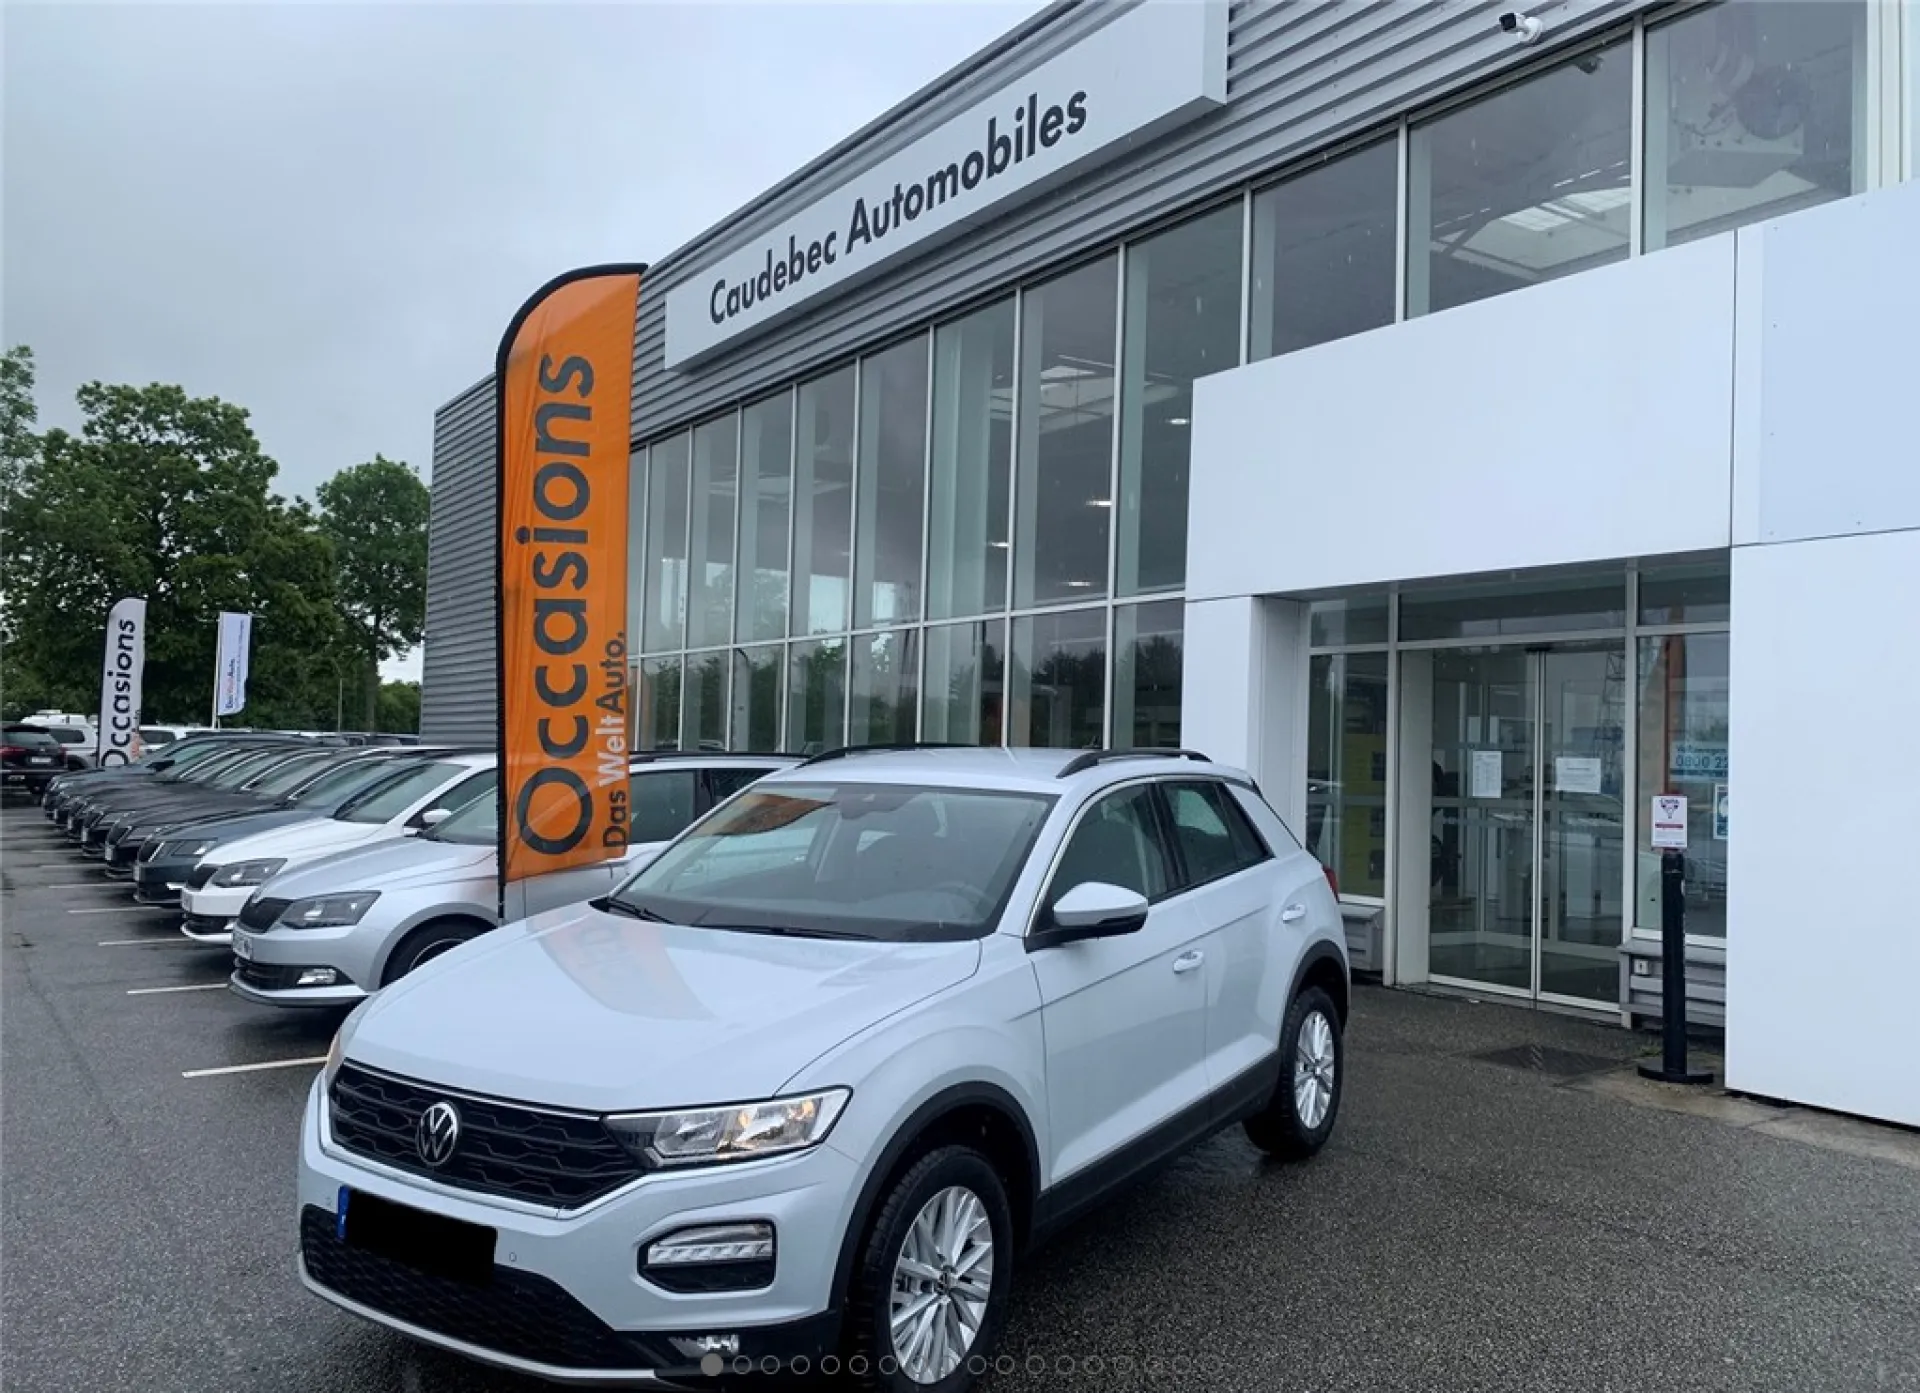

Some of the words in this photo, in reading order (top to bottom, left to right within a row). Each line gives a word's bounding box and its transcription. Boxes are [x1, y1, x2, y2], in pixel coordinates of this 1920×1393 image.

[709, 234, 837, 325] Caudebec
[844, 91, 1088, 255] Automobiles
[514, 352, 595, 856] Occasions
[602, 789, 628, 849] Das
